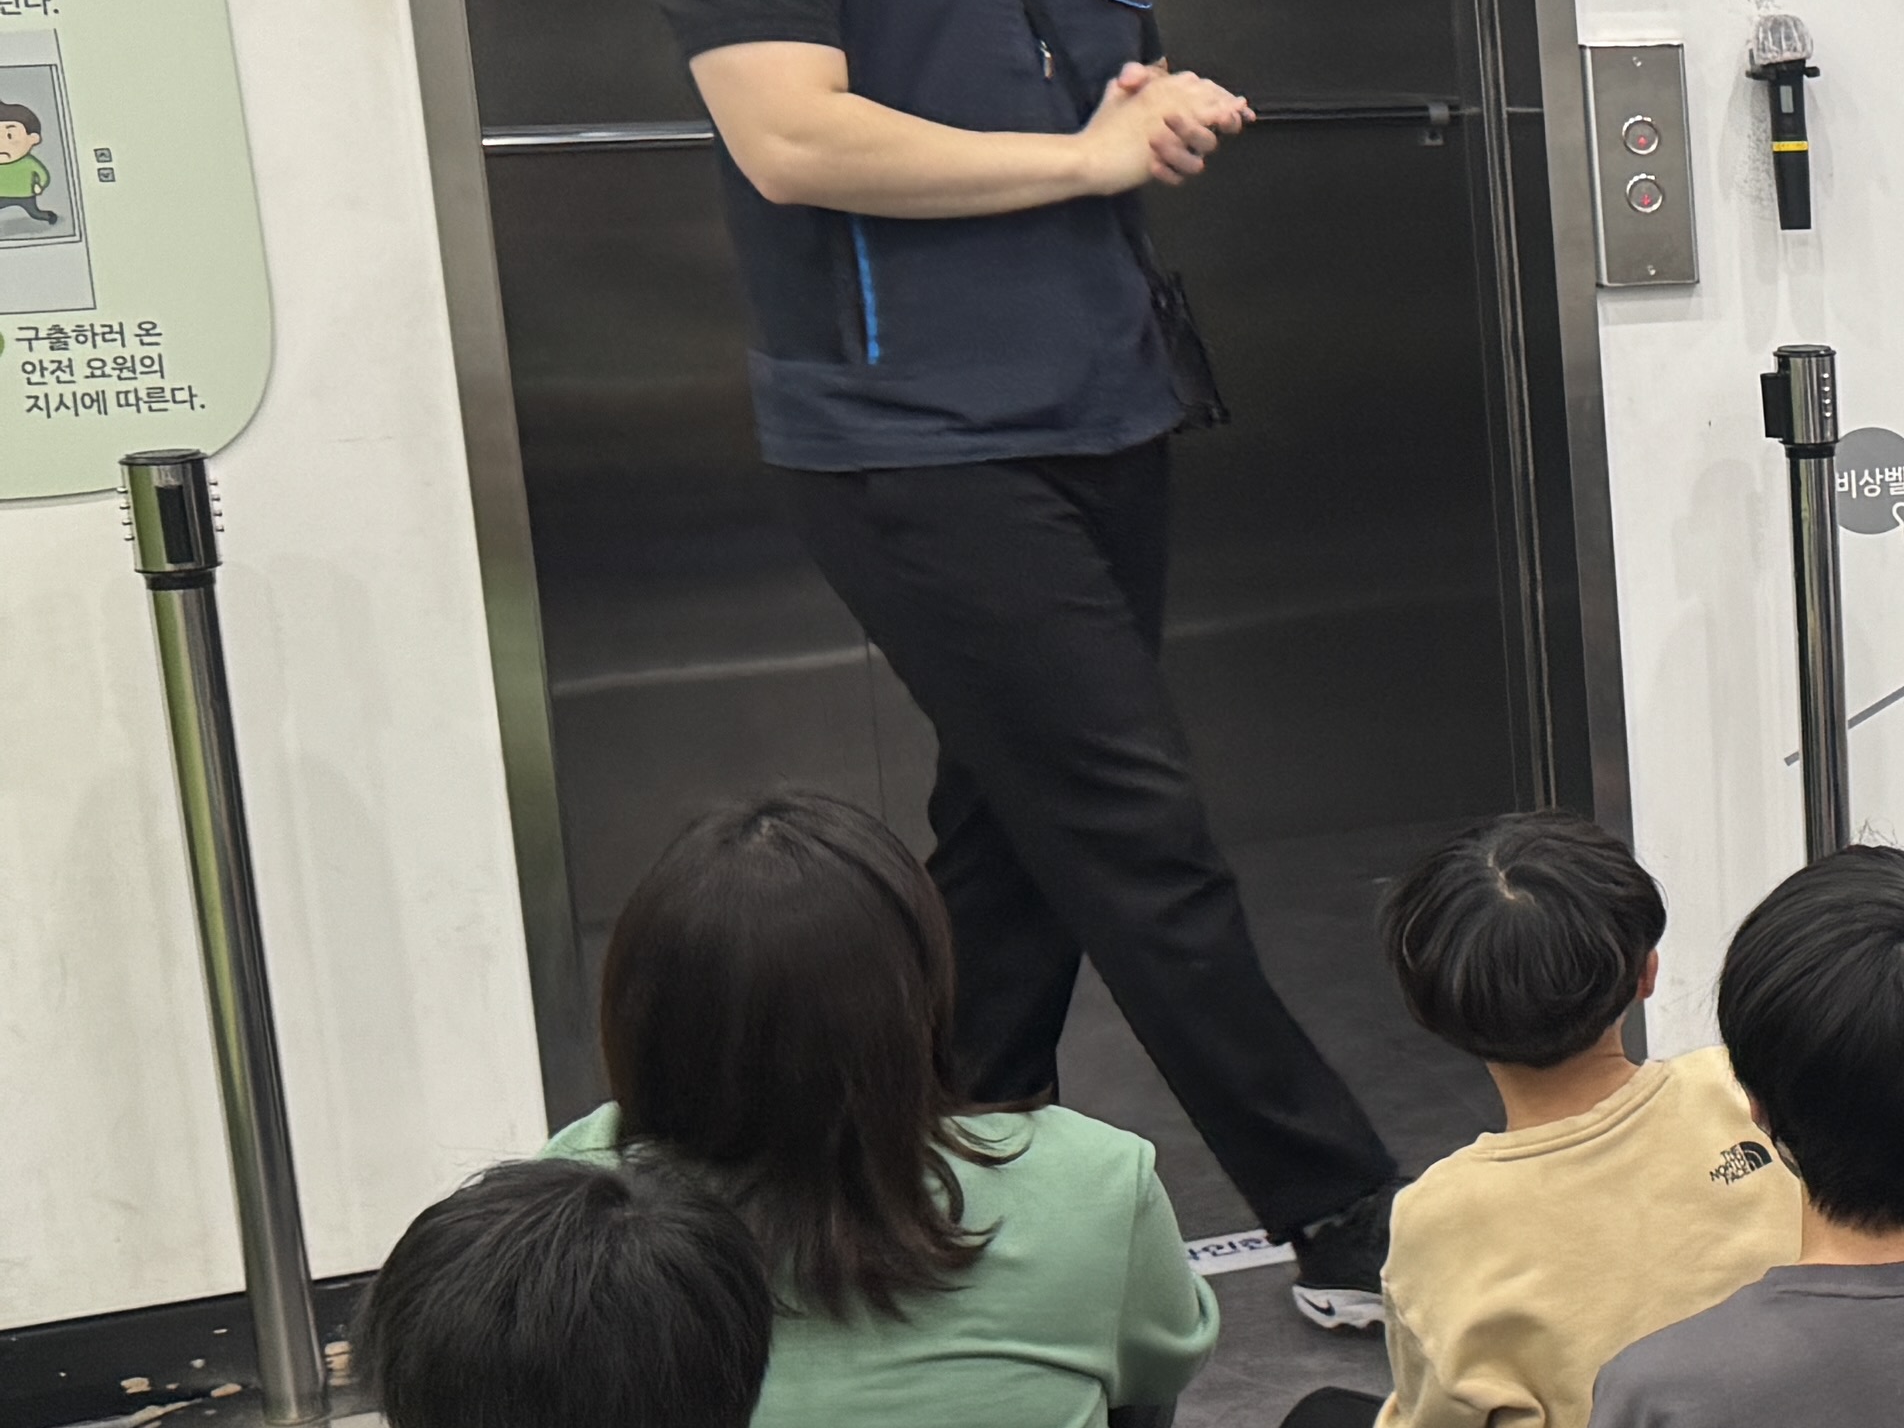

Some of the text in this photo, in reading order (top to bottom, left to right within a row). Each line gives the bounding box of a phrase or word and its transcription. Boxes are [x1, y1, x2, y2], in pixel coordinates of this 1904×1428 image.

[15, 320, 163, 352] 구출하러 온
[21, 352, 165, 386] 안전 요원의
[25, 384, 206, 420] 지시에 따른다.
